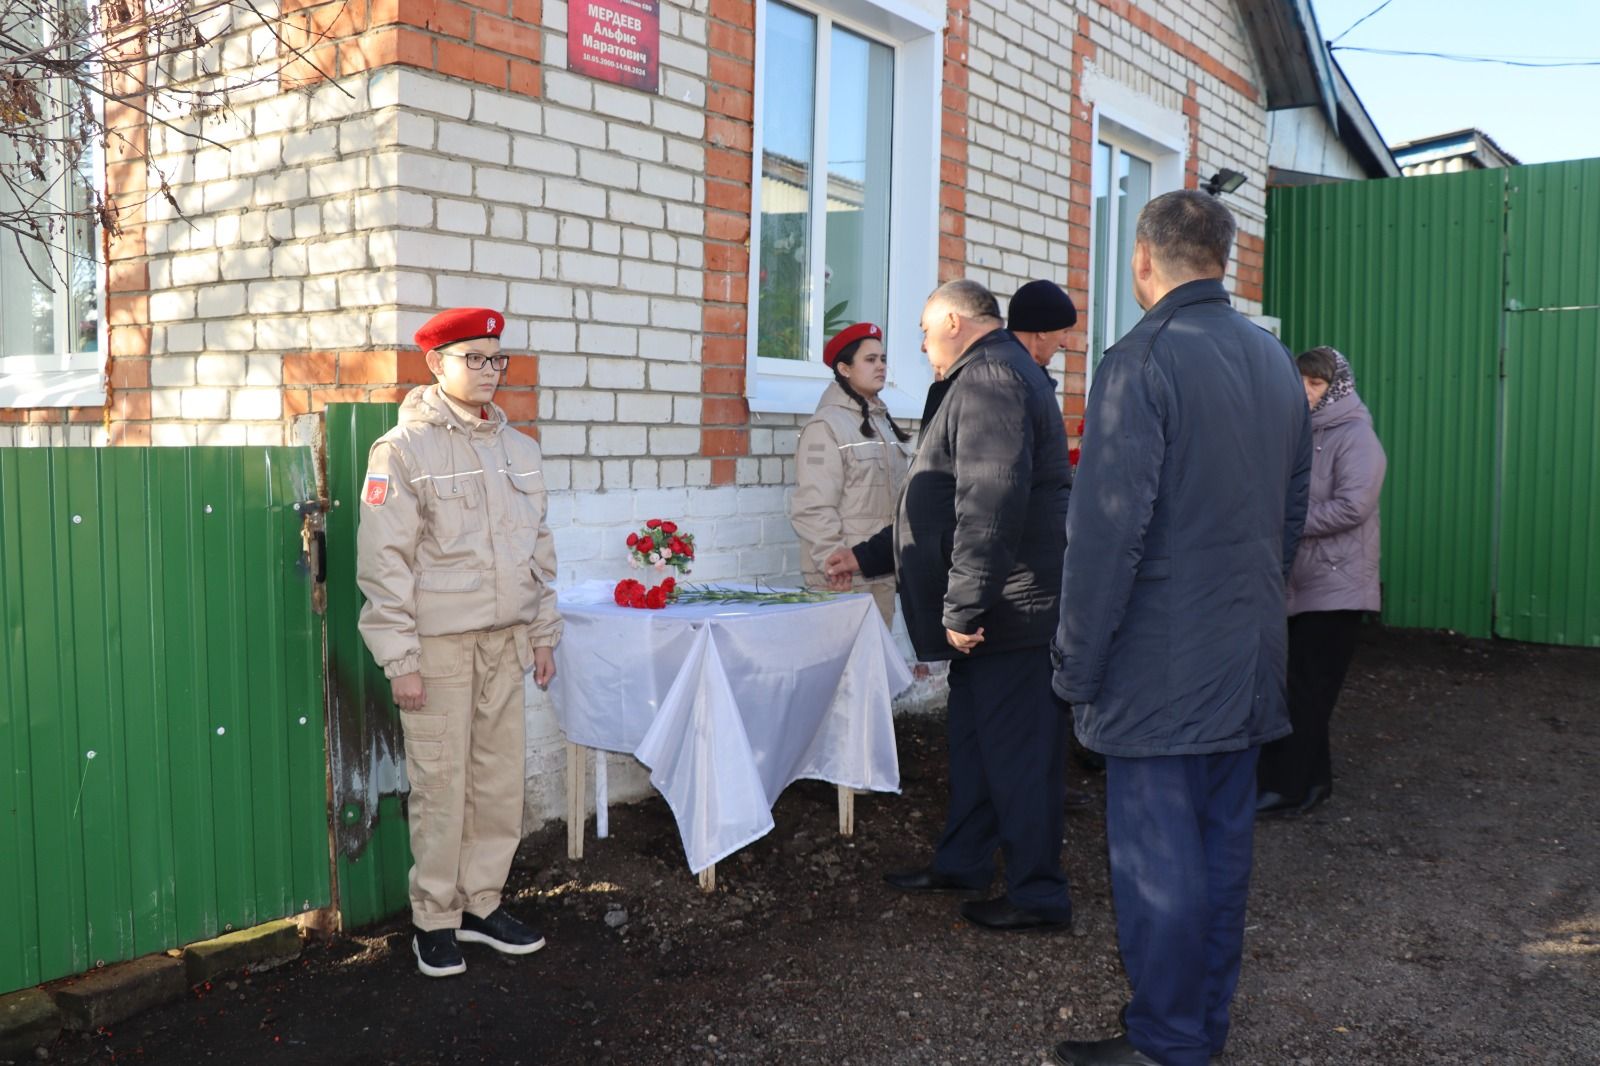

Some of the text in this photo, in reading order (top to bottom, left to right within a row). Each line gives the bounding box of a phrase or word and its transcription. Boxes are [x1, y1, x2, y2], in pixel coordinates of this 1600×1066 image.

[588, 4, 641, 31] МЕРДЕЕВ
[594, 21, 637, 45] Альфис
[582, 33, 647, 64] Маратович
